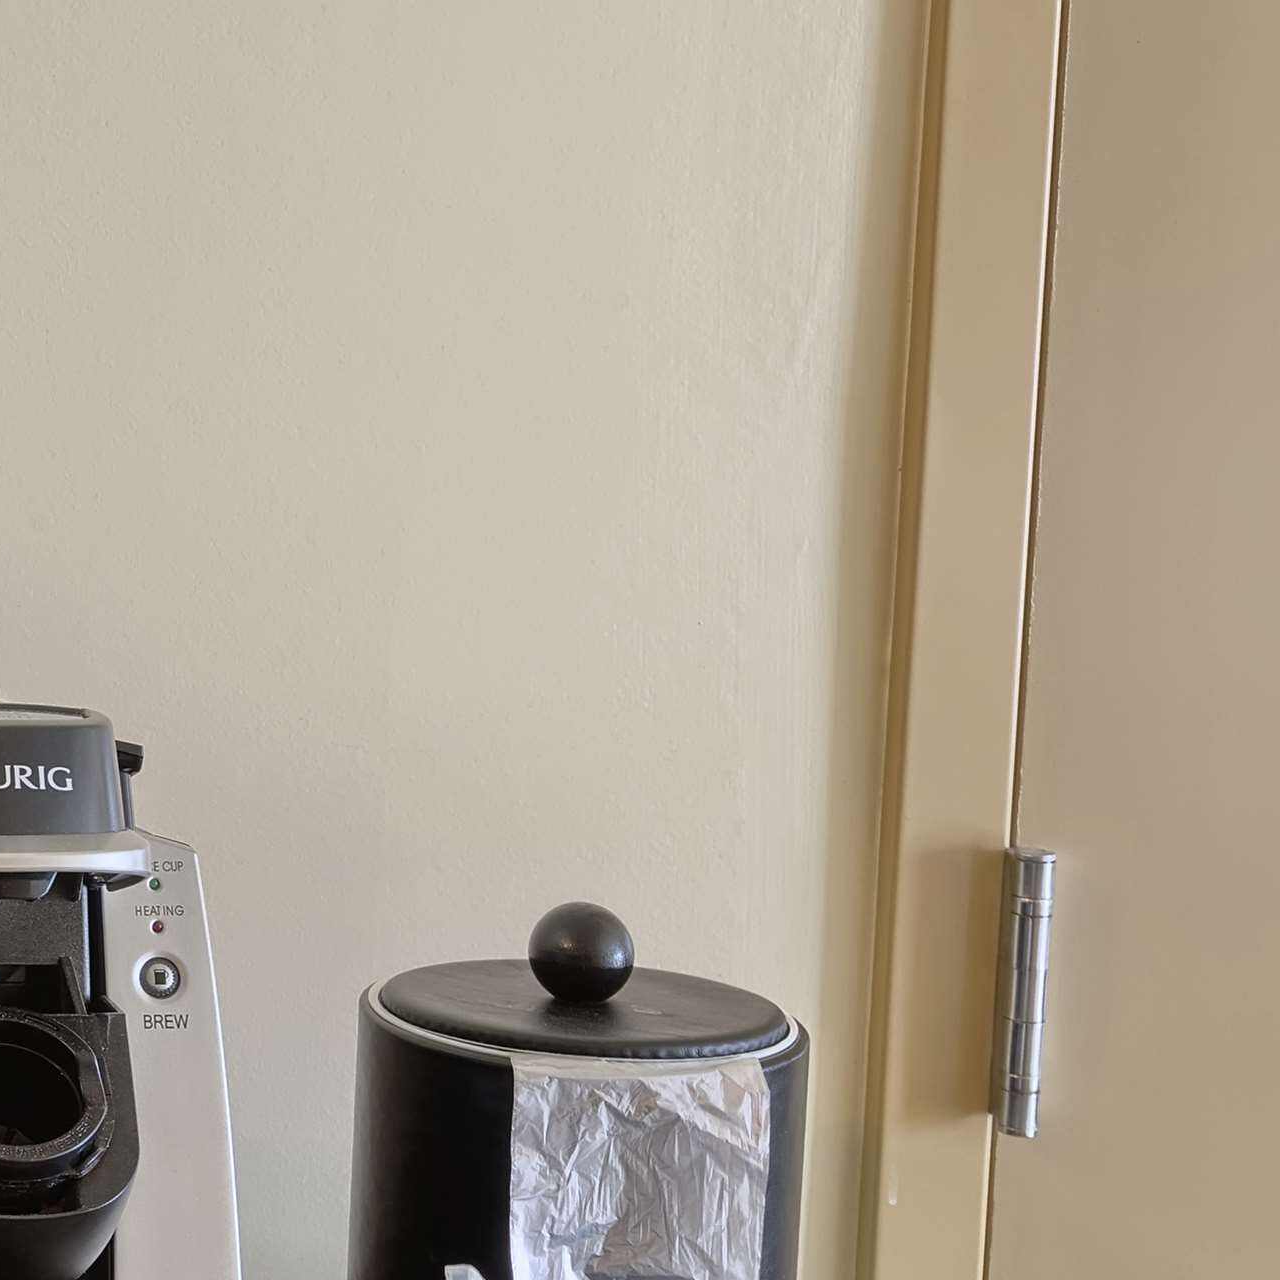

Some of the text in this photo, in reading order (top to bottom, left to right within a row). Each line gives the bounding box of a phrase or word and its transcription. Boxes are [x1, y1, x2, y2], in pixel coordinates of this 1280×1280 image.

[162, 861, 184, 872] CUP
[135, 905, 185, 916] HEATING
[143, 1014, 189, 1029] BREW
